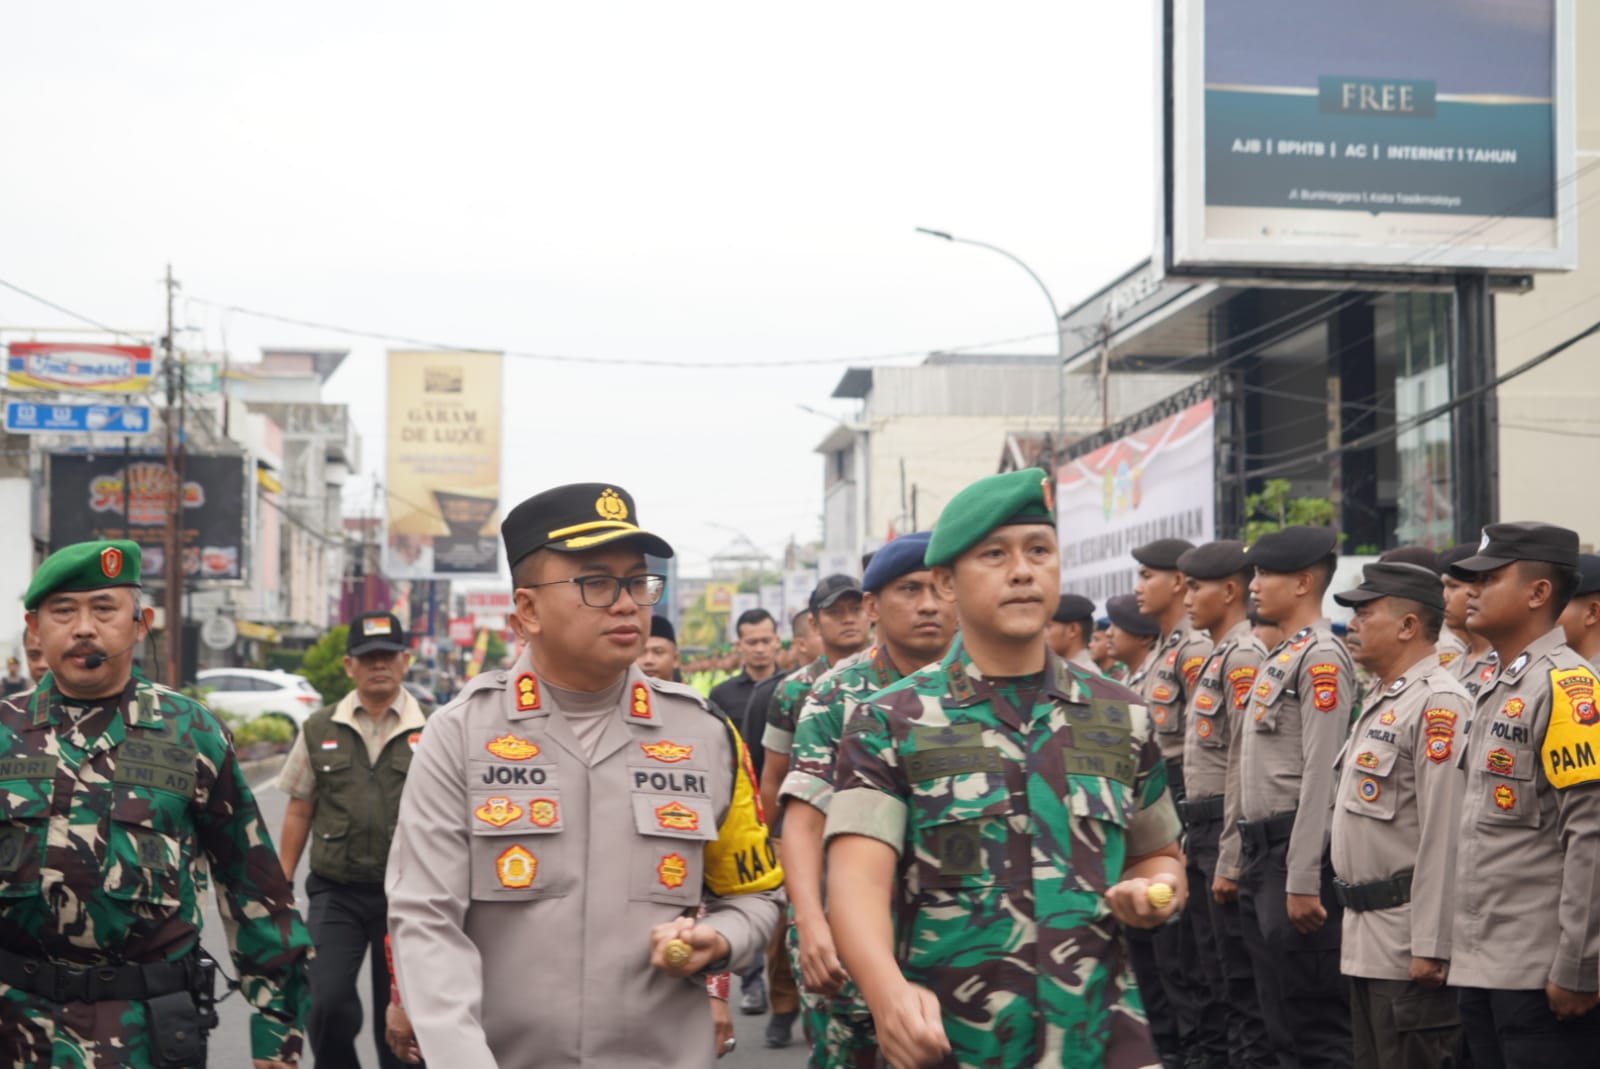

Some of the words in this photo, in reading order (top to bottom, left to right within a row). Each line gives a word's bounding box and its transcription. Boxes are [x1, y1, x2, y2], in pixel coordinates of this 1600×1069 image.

[1341, 82, 1416, 112] FREE
[1232, 138, 1261, 153] AJB
[1344, 143, 1368, 158] AC
[1387, 145, 1454, 161] INTERNET
[1466, 148, 1517, 163] TAHUN
[407, 407, 478, 424] GARAM
[401, 426, 427, 443] DE
[1490, 721, 1529, 745] POLRI
[1549, 741, 1596, 775] PAM
[482, 766, 547, 785] JOKO
[634, 772, 705, 793] POLRI
